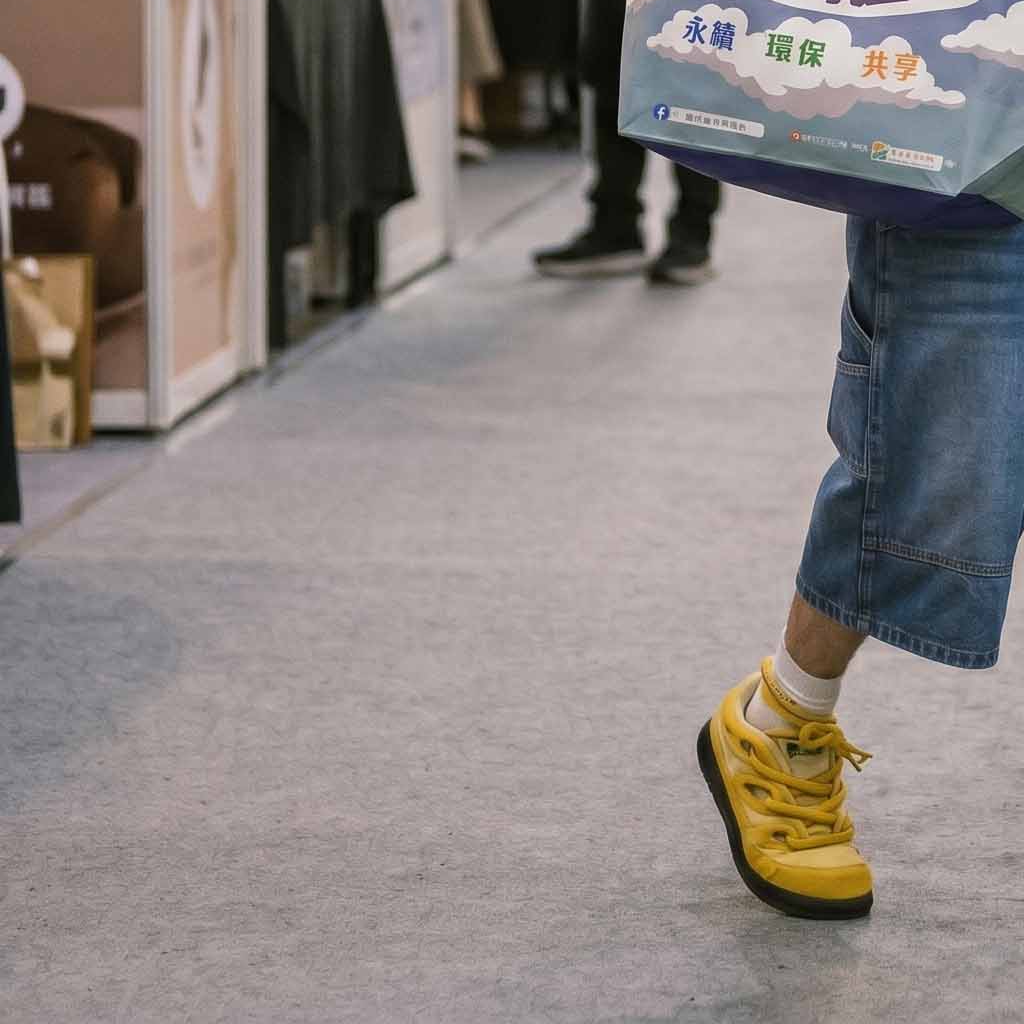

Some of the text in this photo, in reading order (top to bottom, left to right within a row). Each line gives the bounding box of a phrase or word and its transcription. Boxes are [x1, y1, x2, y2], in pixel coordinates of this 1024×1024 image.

[682, 15, 921, 82] 永續 環保 共享
